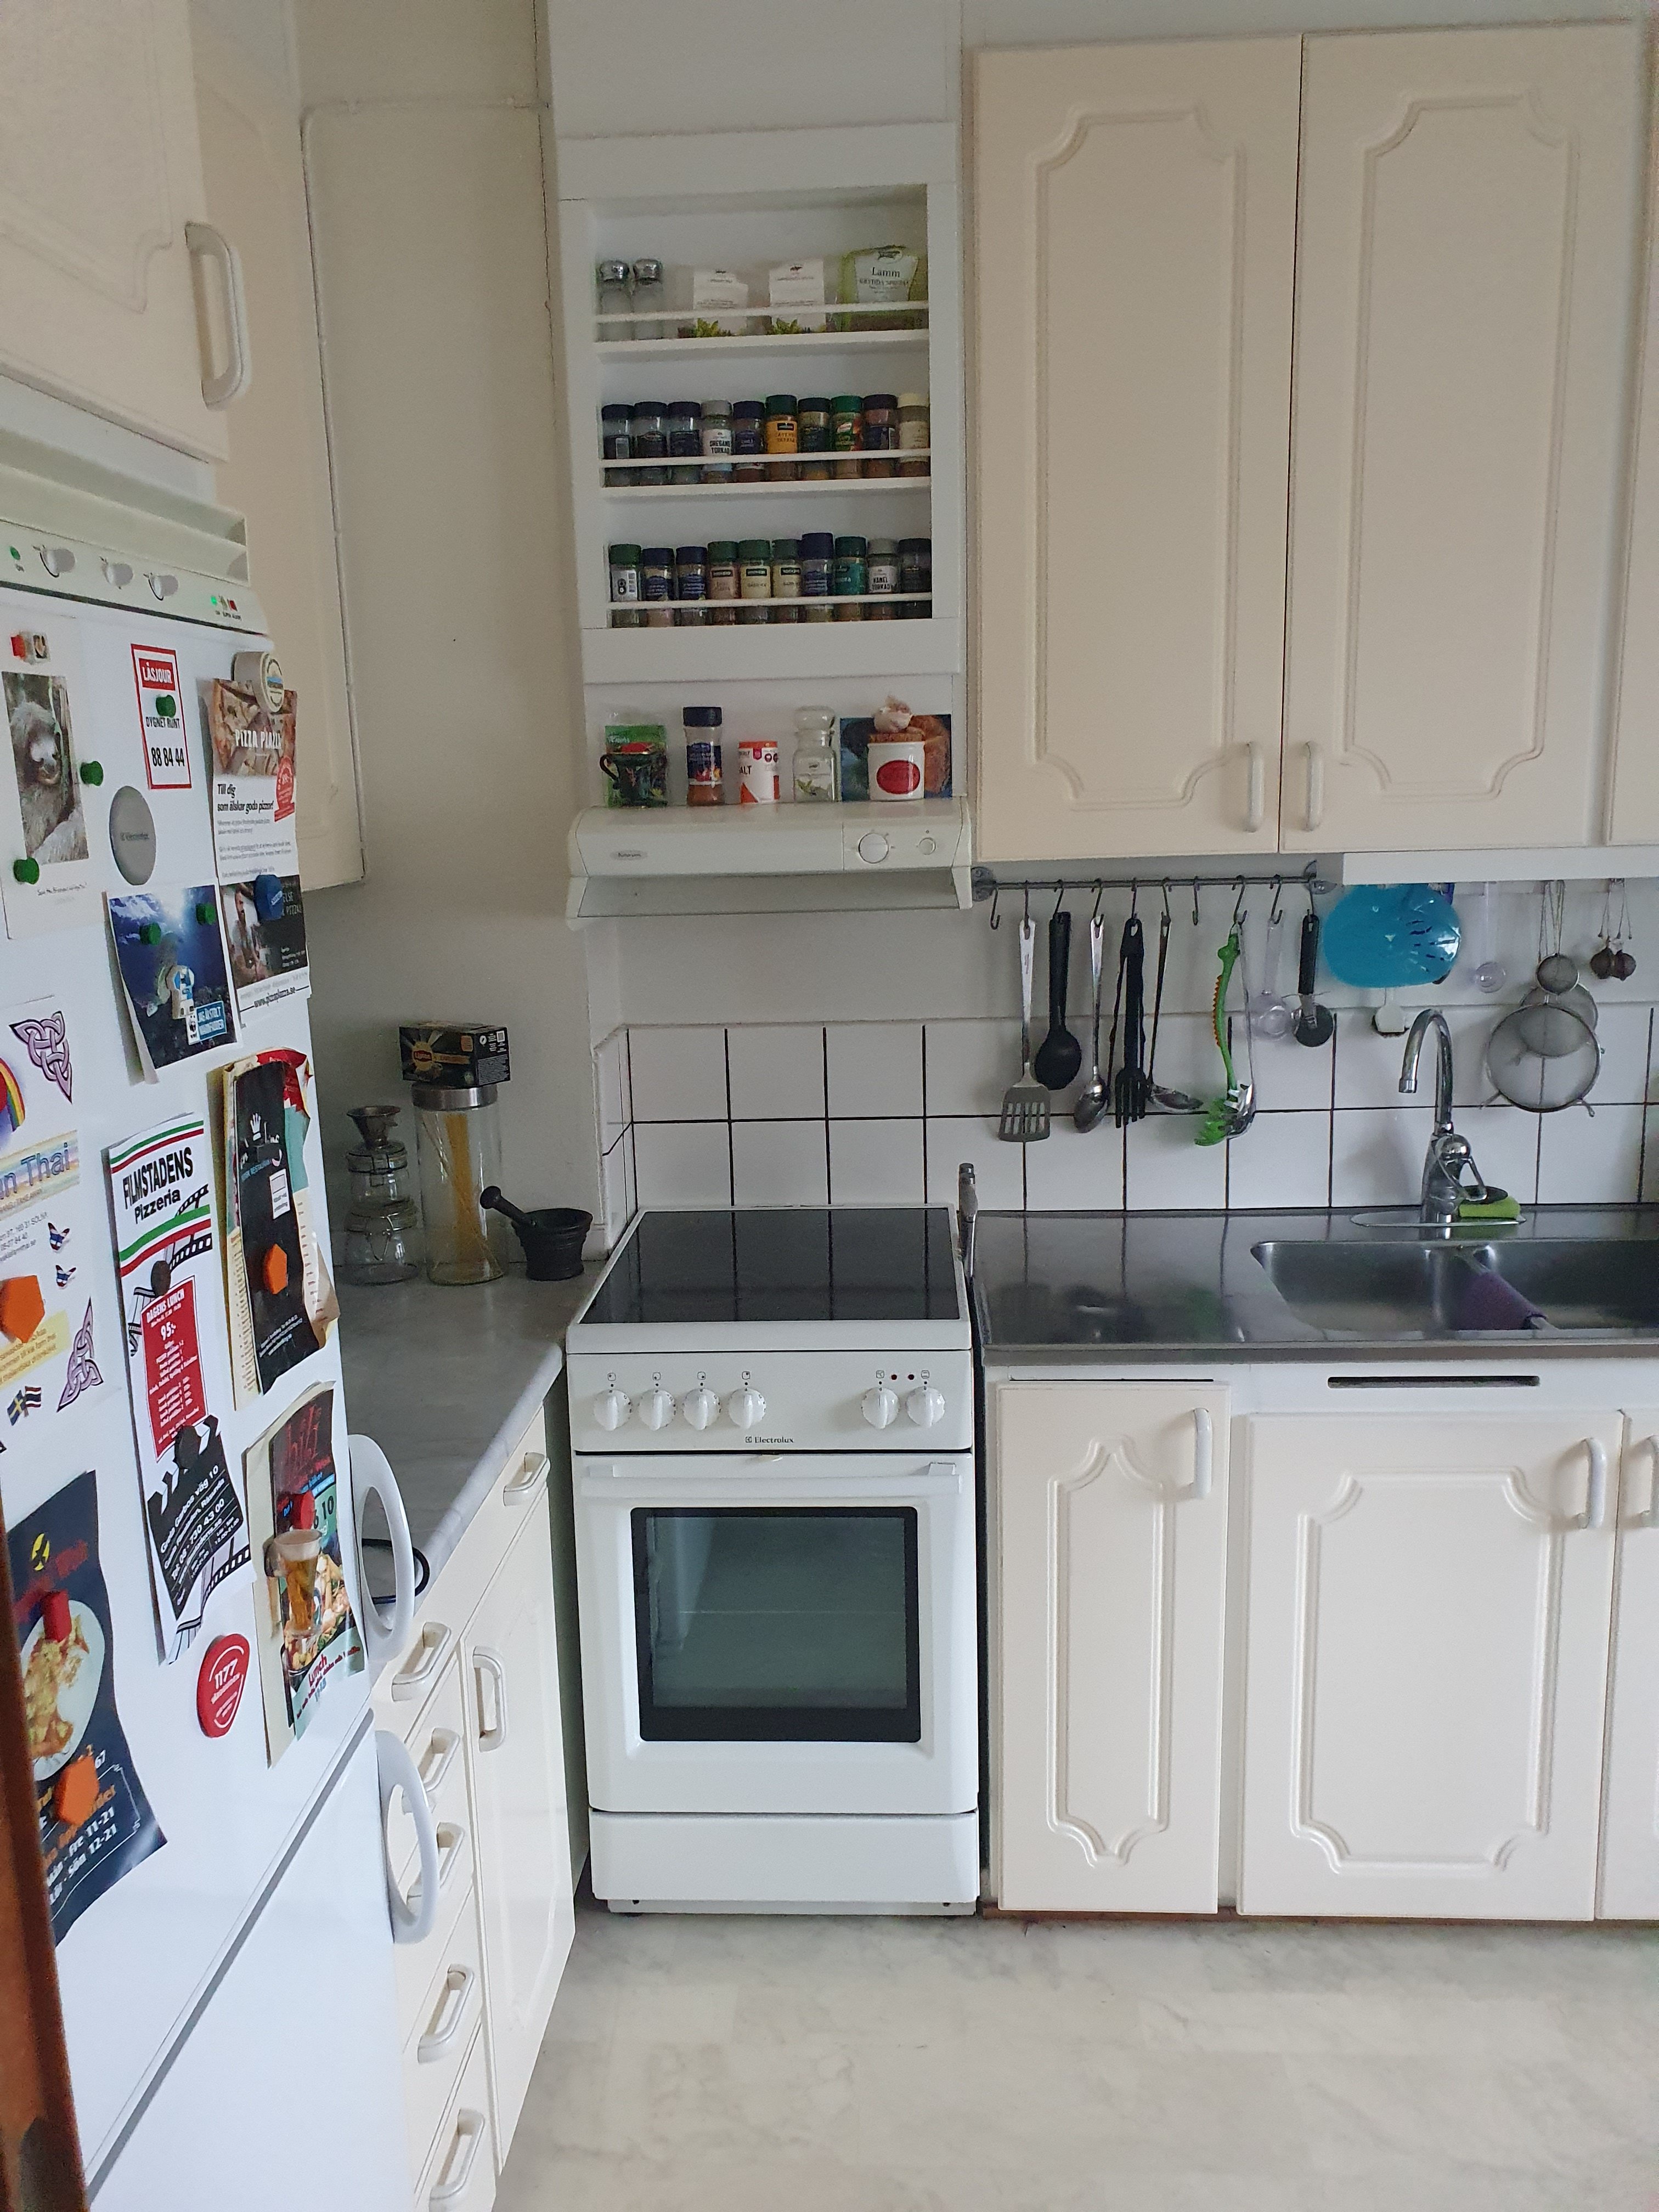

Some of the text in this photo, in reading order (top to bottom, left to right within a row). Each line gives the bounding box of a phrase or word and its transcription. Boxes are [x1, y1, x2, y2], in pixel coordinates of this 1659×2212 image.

[872, 267, 900, 277] Lamm
[142, 662, 173, 684] LÅSJOUR
[146, 716, 180, 729] DYGNET RUNT
[235, 729, 258, 748] PIZZA
[151, 747, 185, 767] 88 84 44
[739, 765, 752, 775] ALT
[217, 783, 236, 799] Till dig
[217, 803, 229, 811] som
[229, 800, 245, 811] älskar
[245, 800, 258, 815] goda
[20, 1142, 70, 1186] Thai
[122, 1147, 193, 1210] FILMSTADENS
[134, 1188, 181, 1224] Pizzeria
[194, 1478, 209, 1496] väg
[208, 1465, 219, 1479] 10
[189, 1523, 202, 1545] 730
[203, 1510, 215, 1526] 43
[215, 1498, 224, 1513] 00
[321, 1495, 335, 1521] 10
[215, 1658, 238, 1690] 1177
[308, 1653, 328, 1688] Lunch
[86, 1806, 114, 1837] 11-21
[88, 1822, 117, 1855] 12-21
